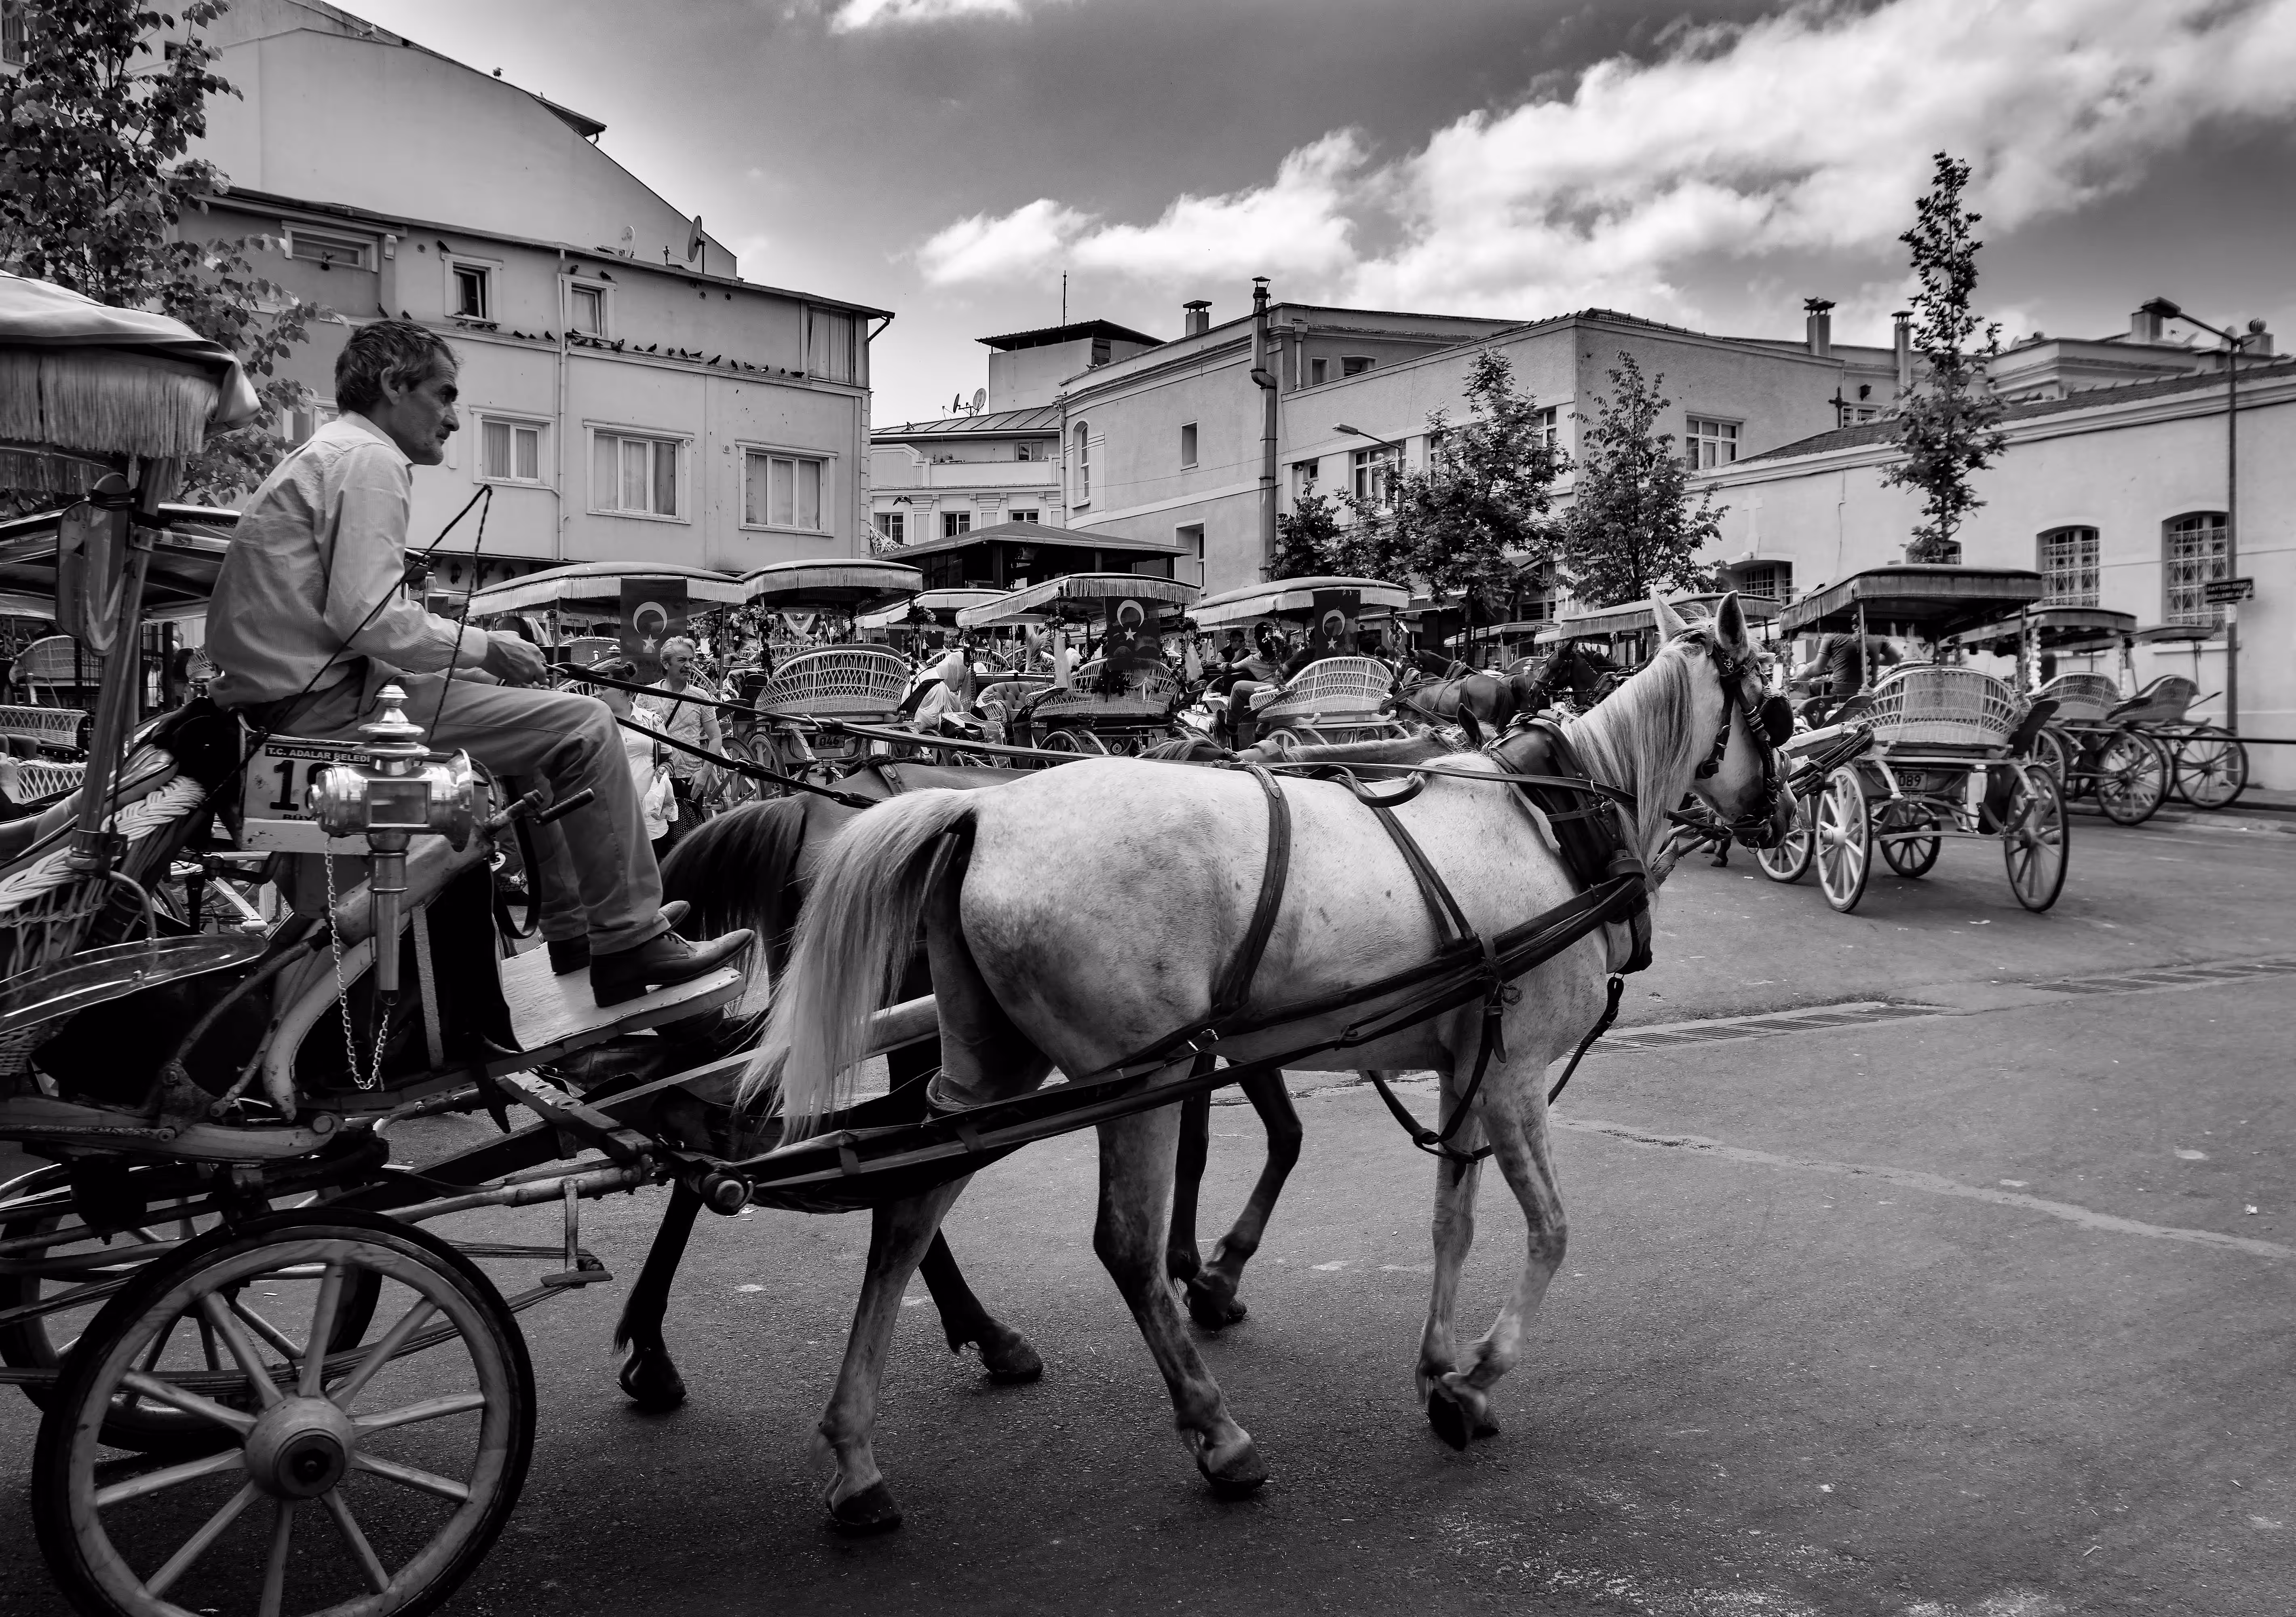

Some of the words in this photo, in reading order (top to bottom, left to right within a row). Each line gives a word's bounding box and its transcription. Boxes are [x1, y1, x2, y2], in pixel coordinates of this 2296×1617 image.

[819, 737, 840, 746] 046
[289, 749, 331, 759] ADALAR
[1899, 776, 1922, 787] 089
